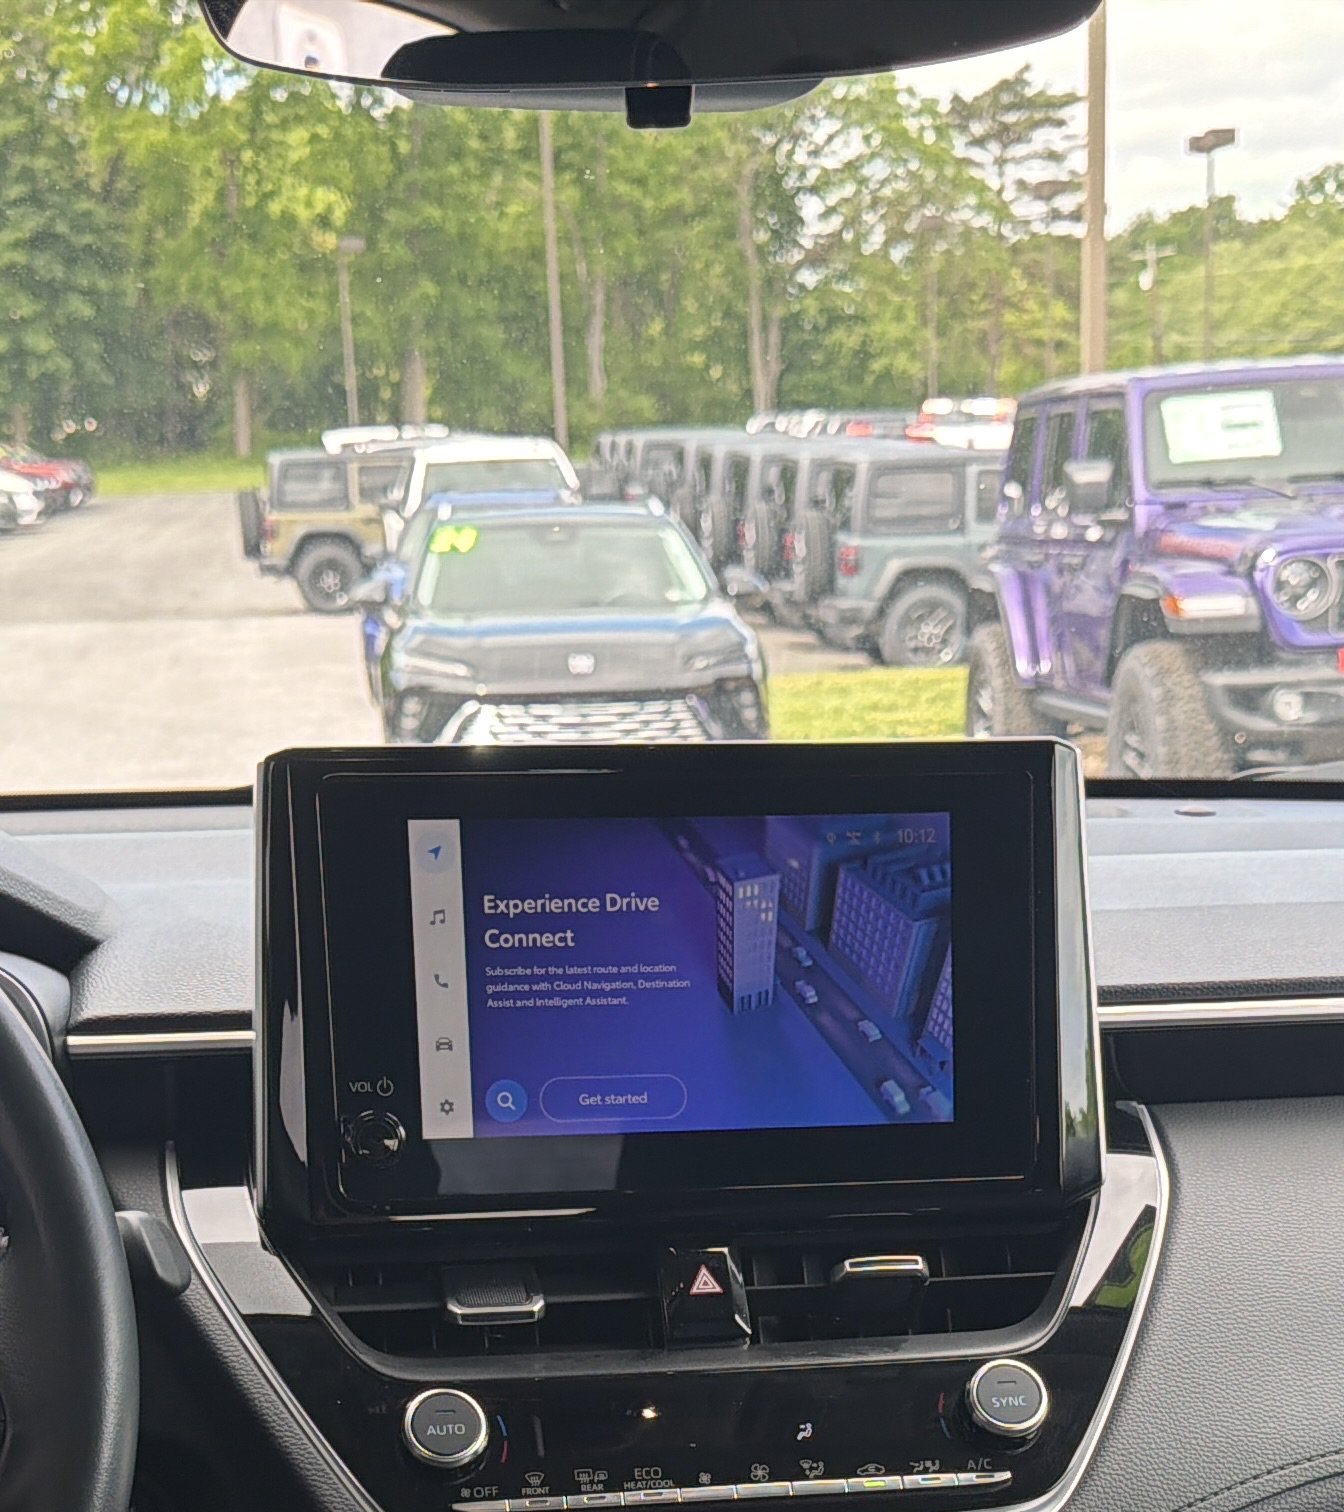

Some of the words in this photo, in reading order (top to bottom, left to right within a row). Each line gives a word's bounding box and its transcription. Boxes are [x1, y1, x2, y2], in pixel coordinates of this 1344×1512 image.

[897, 828, 937, 844] 10:12
[483, 893, 600, 918] Experience
[606, 891, 660, 912] Drive
[484, 928, 575, 949] Connect
[485, 965, 532, 976] Subscribe
[533, 965, 547, 976] for
[548, 965, 564, 975] the
[565, 964, 591, 975] latest
[593, 965, 618, 975] route
[619, 964, 638, 974] and
[640, 963, 677, 974] location
[486, 982, 530, 994] guidance
[532, 981, 552, 992] with
[553, 980, 582, 991] Cloud
[584, 979, 636, 993] Navigation,
[638, 978, 691, 990] Destination
[487, 997, 514, 1008] Assist
[515, 997, 535, 1008] and
[536, 996, 583, 1009] Intelligent
[349, 1081, 374, 1094] VOL
[578, 1092, 602, 1106] Get
[605, 1091, 648, 1105] started
[991, 1395, 1027, 1408] SYNC
[427, 1423, 466, 1436] AUTO
[967, 1458, 993, 1471] A/C
[634, 1467, 662, 1480] ECO
[581, 1483, 604, 1492] REAR
[623, 1478, 675, 1489] HEAT/COOL
[473, 1486, 500, 1498] OFF
[521, 1486, 550, 1496] FRONT
